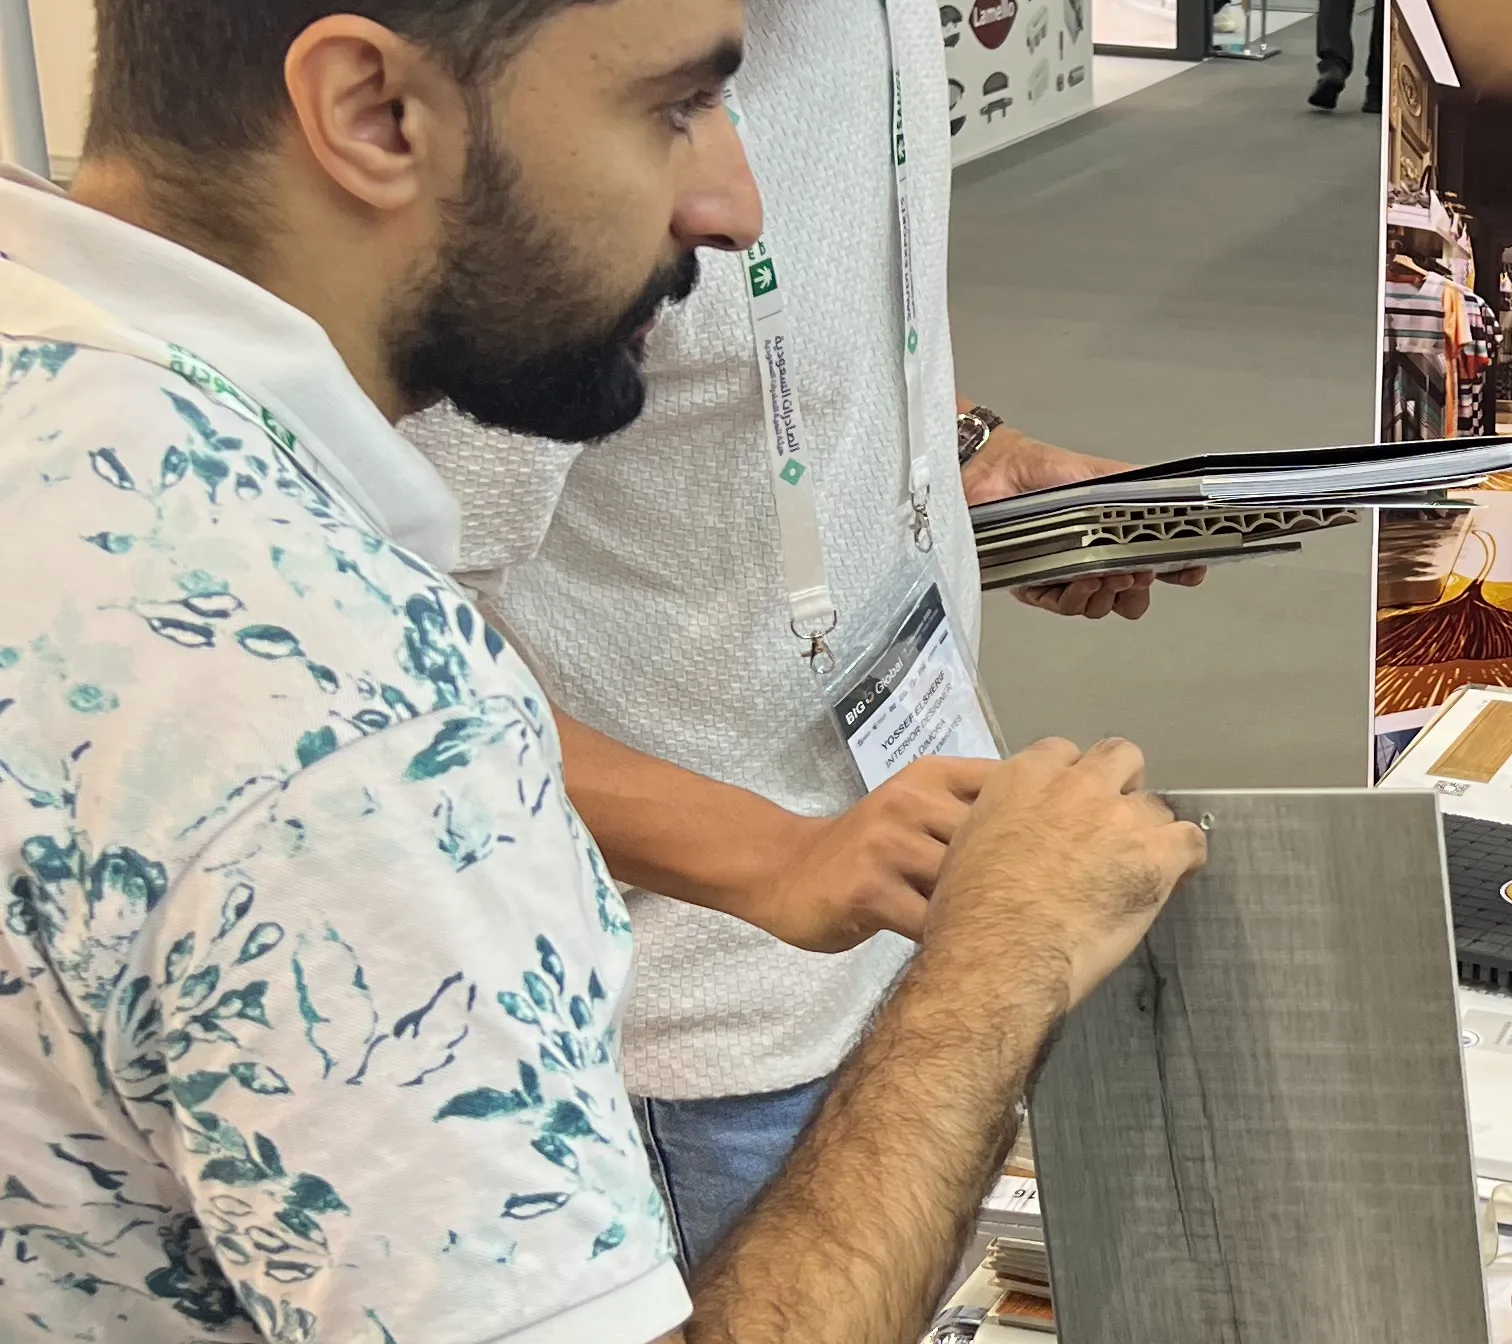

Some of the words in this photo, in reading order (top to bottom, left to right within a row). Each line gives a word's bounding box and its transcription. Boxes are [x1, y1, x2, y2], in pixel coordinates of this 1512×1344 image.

[844, 698, 867, 726] BIG
[874, 657, 905, 695] Global
[880, 712, 916, 752] YOSSEF
[914, 669, 946, 718] ELSHERIF
[885, 725, 922, 770] INTERIOR
[920, 682, 954, 730] DESIGNER
